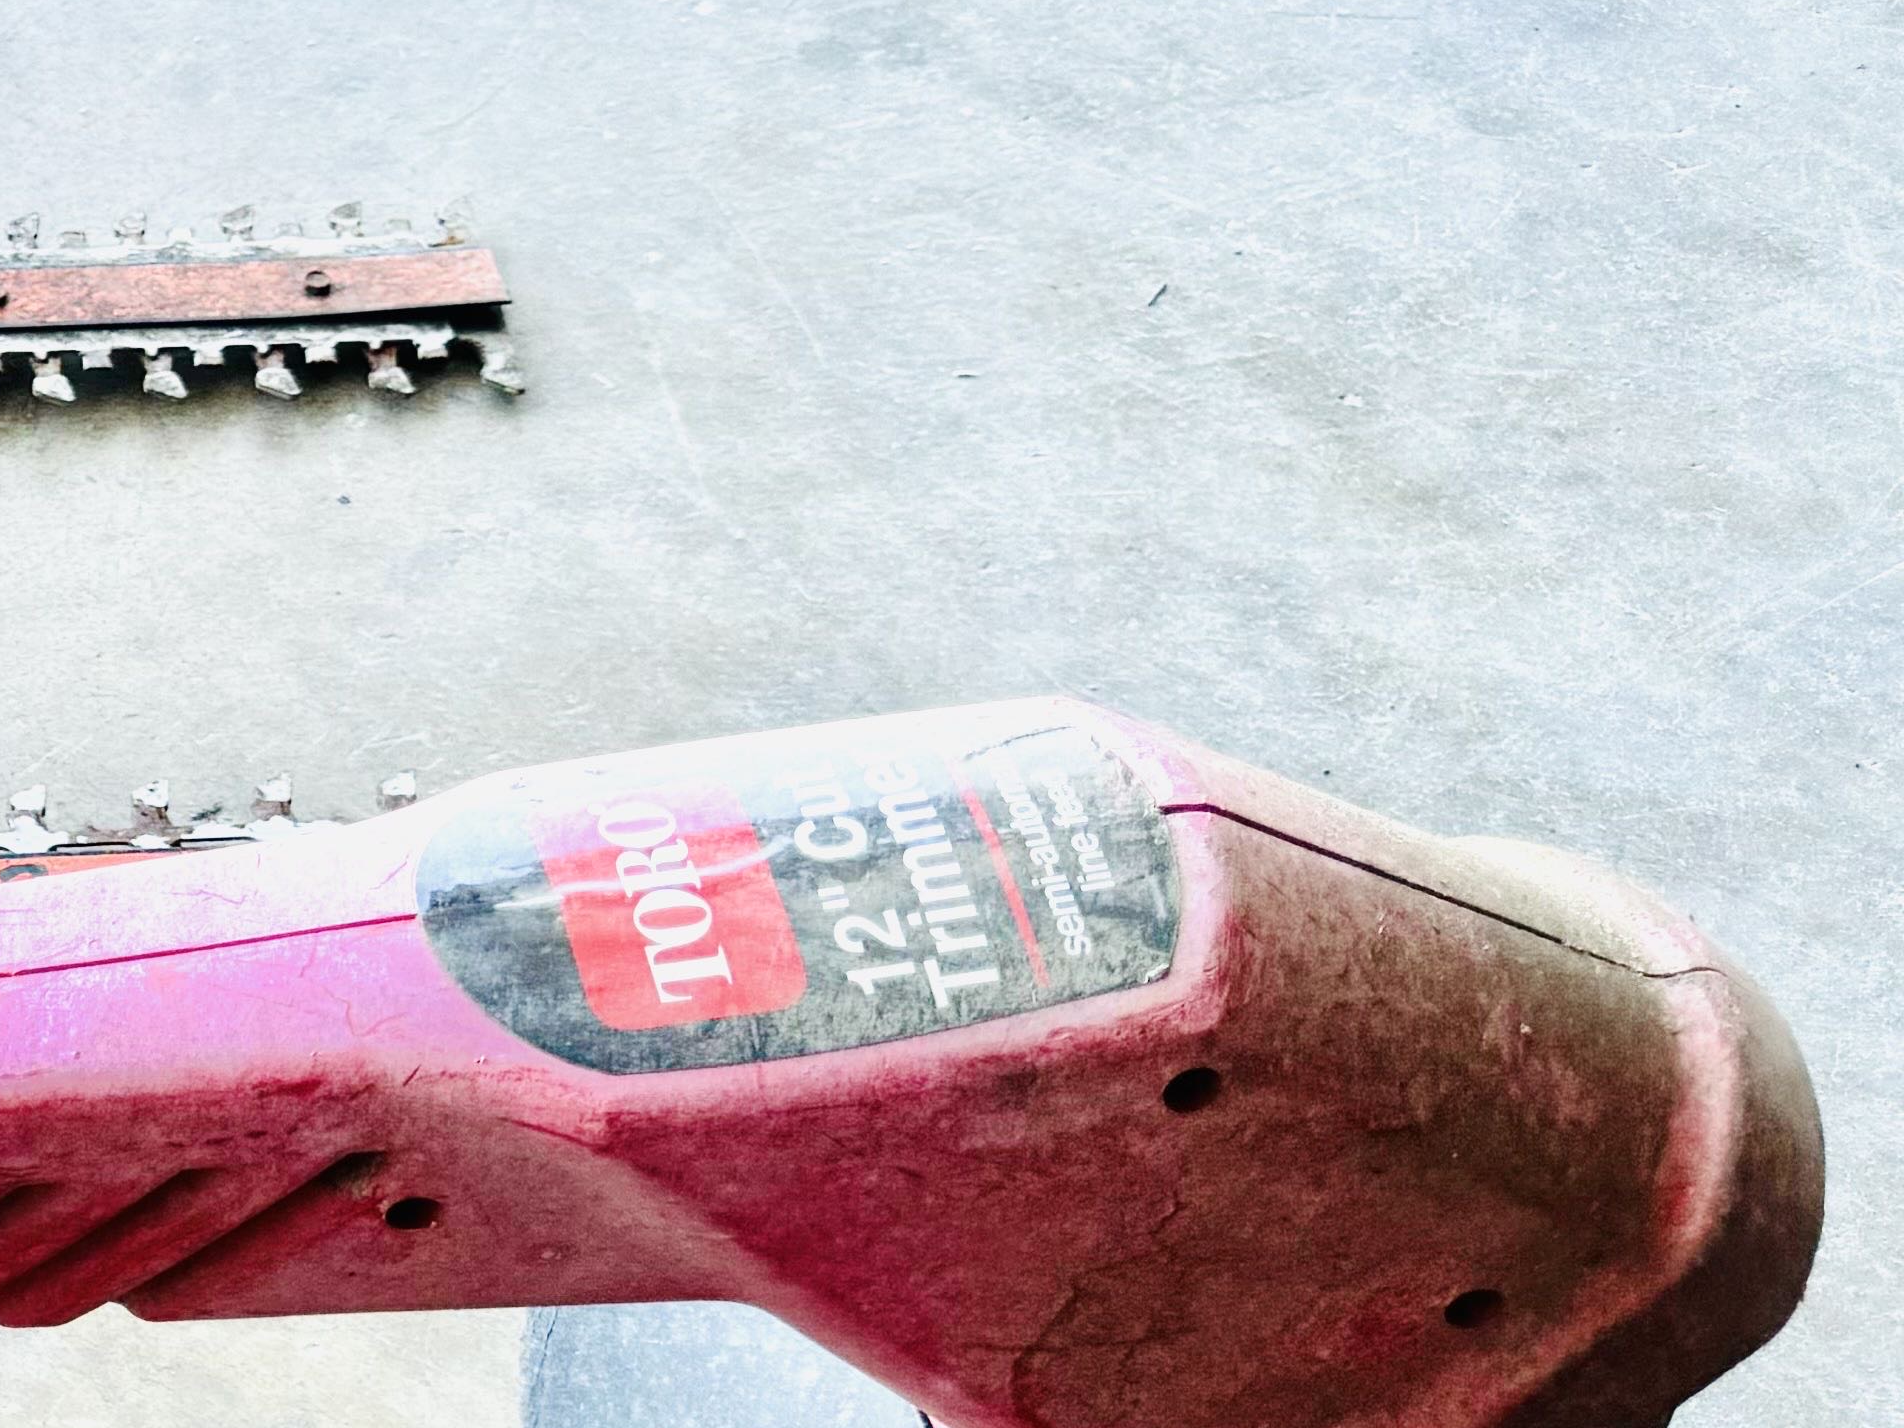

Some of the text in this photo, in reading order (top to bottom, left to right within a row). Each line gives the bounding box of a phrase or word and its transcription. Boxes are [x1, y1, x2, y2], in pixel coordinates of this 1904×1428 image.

[597, 801, 734, 1004] TORO
[817, 884, 917, 996] 12"
[862, 758, 1001, 1009] Trimme
[1069, 832, 1116, 892] line
